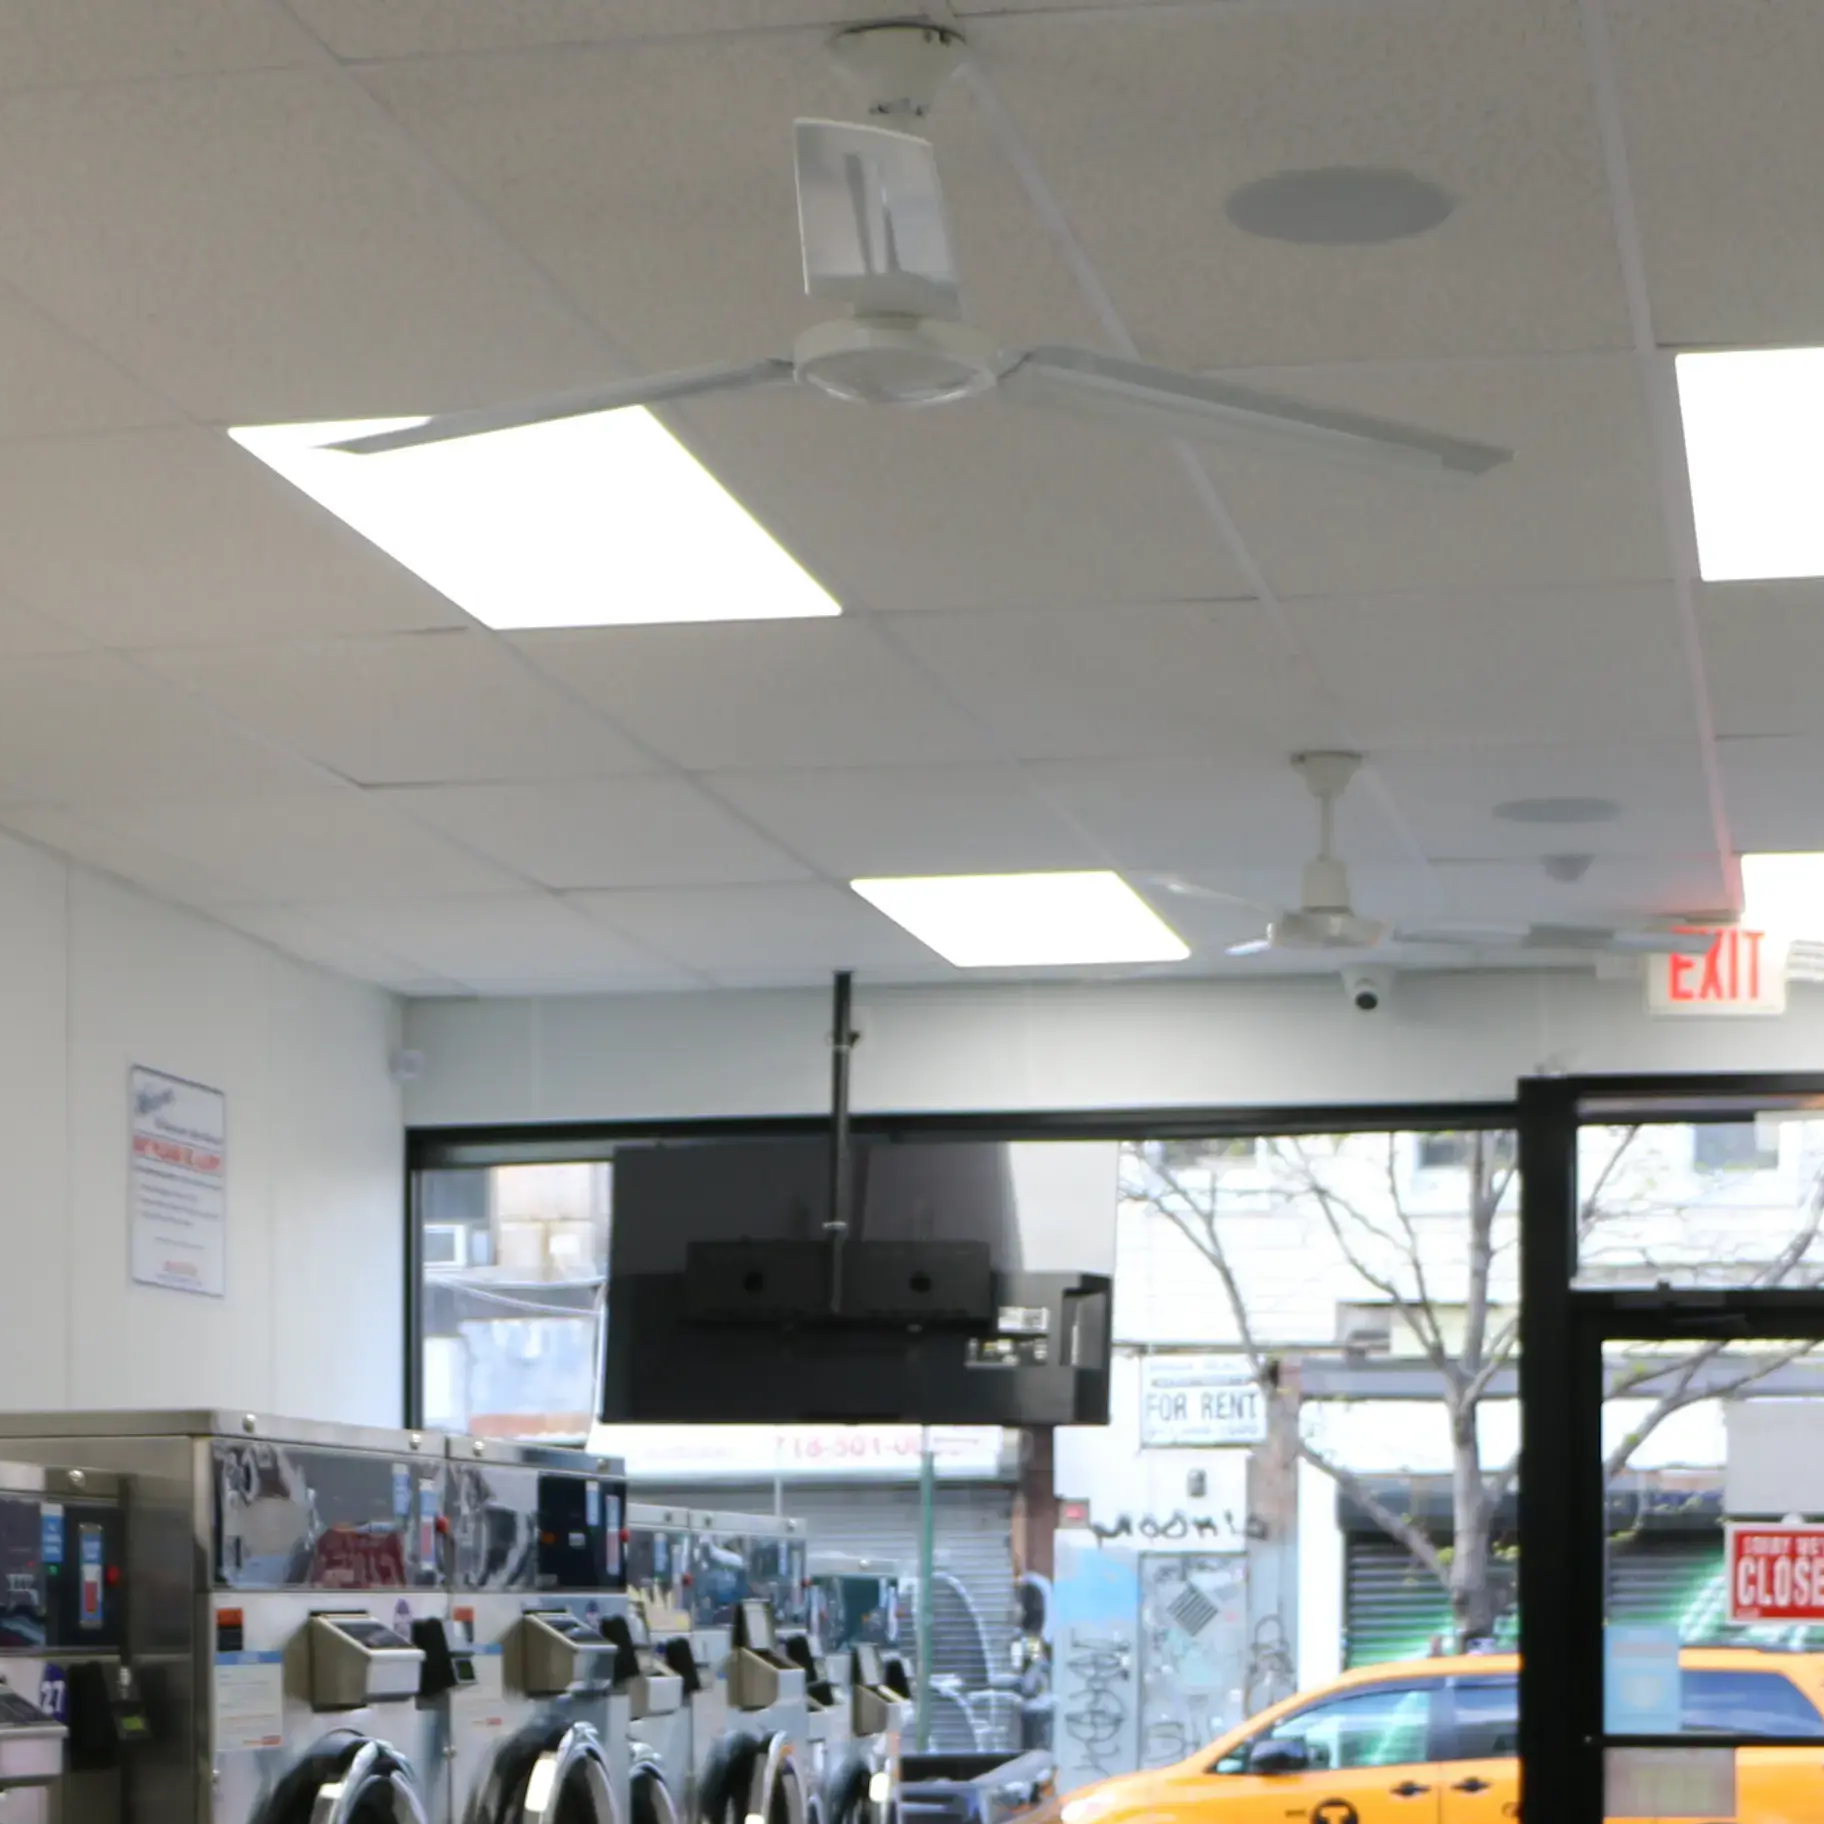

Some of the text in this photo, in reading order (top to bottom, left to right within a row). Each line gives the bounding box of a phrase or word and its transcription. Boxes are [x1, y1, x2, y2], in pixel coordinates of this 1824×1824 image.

[1669, 925, 1765, 1000] EXIT
[1146, 1393, 1258, 1421] FOR RENT
[41, 1681, 65, 1714] 27
